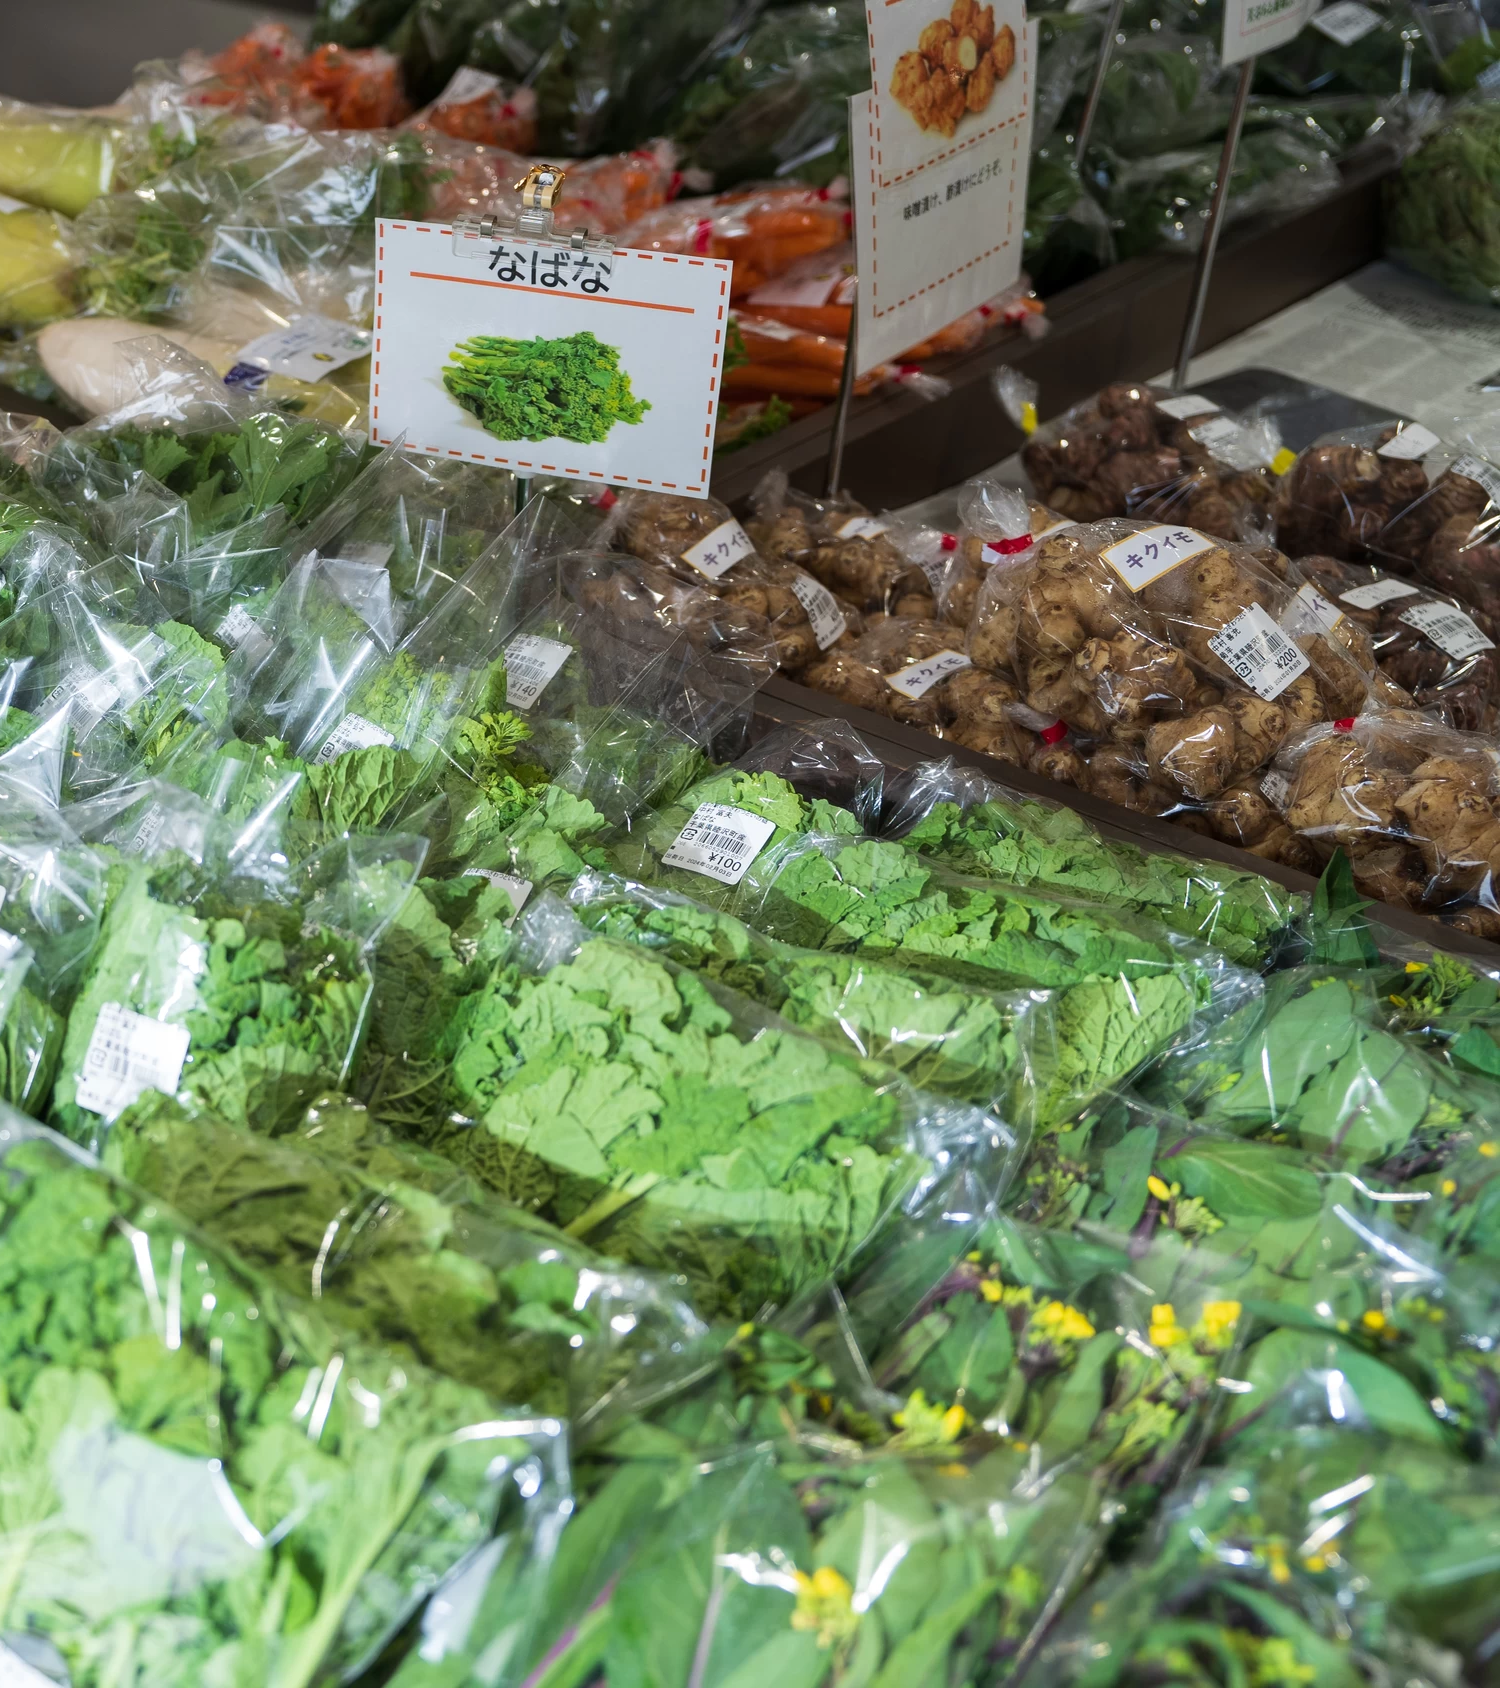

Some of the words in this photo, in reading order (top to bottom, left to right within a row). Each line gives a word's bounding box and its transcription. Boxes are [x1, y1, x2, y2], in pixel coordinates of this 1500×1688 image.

[489, 246, 611, 293] なばな
[1126, 531, 1194, 568] キクイモ
[1212, 639, 1227, 652] 中村
[1274, 647, 1297, 670] ¥200
[906, 658, 964, 687] キクイモ
[509, 680, 537, 697] ¥140
[692, 813, 716, 823] なばな
[699, 806, 715, 815] 中村
[689, 820, 747, 842] 千葉県睦沢町産
[665, 853, 685, 861] 出荷日
[686, 858, 733, 878] 2024年02月03日
[708, 852, 742, 872] ¥100
